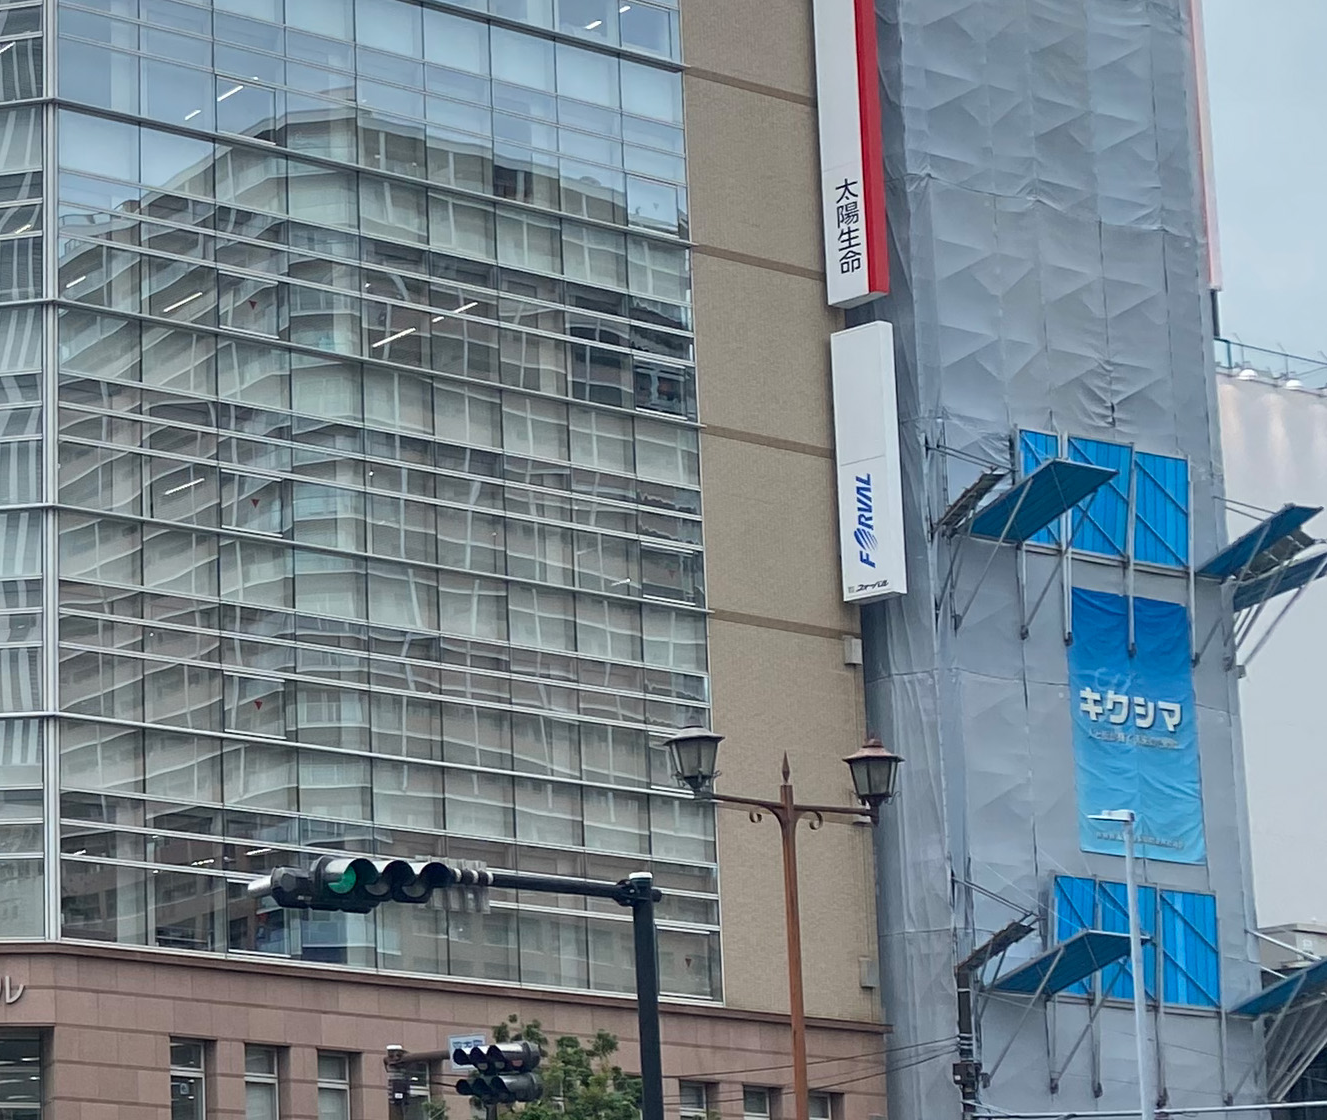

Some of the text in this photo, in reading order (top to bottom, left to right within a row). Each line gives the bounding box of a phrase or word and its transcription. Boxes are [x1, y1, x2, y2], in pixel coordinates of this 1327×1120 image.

[835, 178, 862, 274] 太陽生命
[1079, 686, 1182, 733] キクシマ
